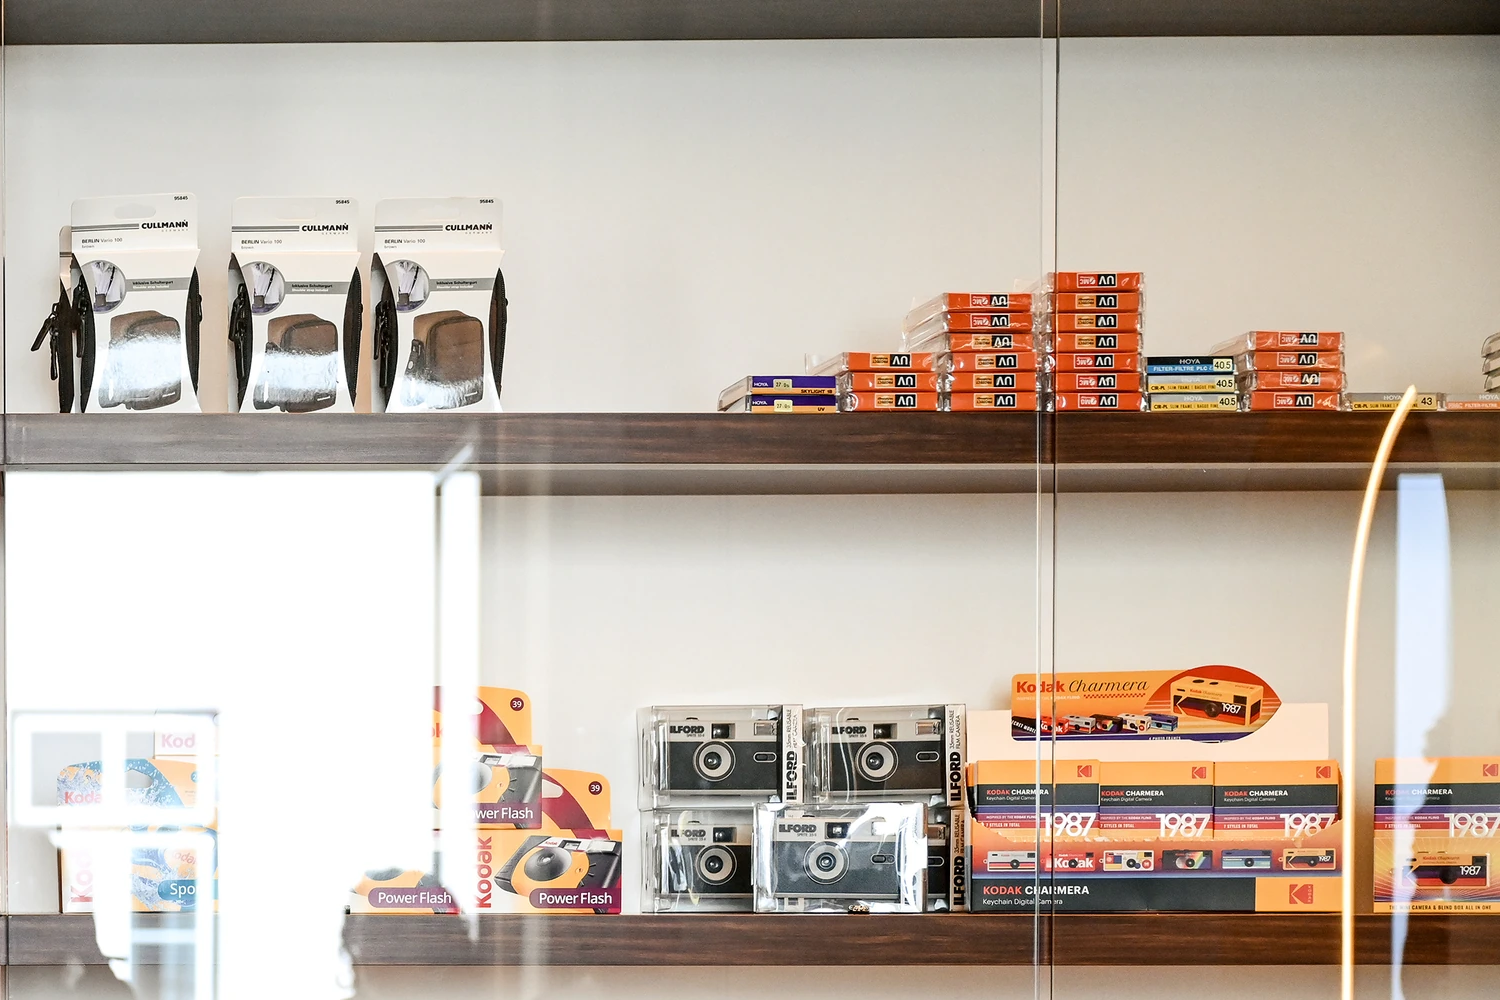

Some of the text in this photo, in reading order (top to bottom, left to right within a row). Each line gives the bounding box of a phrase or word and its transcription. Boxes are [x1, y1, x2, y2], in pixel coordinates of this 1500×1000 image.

[141, 220, 189, 230] CULLMANN
[302, 222, 349, 232] CULLMANN
[445, 222, 492, 232] CULLMANN
[1099, 276, 1116, 286] UV
[991, 296, 1008, 306] UV
[1099, 296, 1115, 306] UV
[992, 316, 1008, 326] UV
[1098, 316, 1115, 326] UV
[994, 336, 1011, 346] UV
[1099, 336, 1115, 346] UV
[1300, 334, 1316, 344] UV
[892, 356, 908, 365] UV
[998, 356, 1016, 366] UV
[1096, 356, 1113, 366] UV
[1299, 354, 1316, 364] UV
[1214, 361, 1232, 370] 40.5
[897, 376, 914, 386] UV
[996, 376, 1013, 386] UV
[1099, 376, 1116, 386] UV
[1216, 380, 1234, 388] 40.5
[1301, 374, 1318, 384] UV
[897, 396, 914, 406] UV
[997, 396, 1014, 406] UV
[1100, 396, 1116, 406] UV
[1219, 398, 1236, 406] 40.5
[1420, 397, 1433, 406] 43
[1016, 679, 1150, 694] Kodak Charmera
[512, 700, 522, 708] 39
[1221, 702, 1242, 714] 1987
[669, 724, 705, 734] ILFORD
[832, 725, 867, 735] ILFORD
[786, 750, 797, 801] ILFORD
[950, 752, 962, 802] ILFORD
[590, 784, 600, 792] 39
[501, 807, 534, 820] Flash
[778, 824, 817, 834] ILFORD
[1040, 812, 1096, 837] 1987
[1155, 813, 1211, 838] 1987
[1280, 812, 1336, 838] 1987
[476, 836, 492, 908] Kodak
[1460, 866, 1481, 875] 1987
[953, 856, 965, 906] ILFORD
[983, 886, 1090, 895] KODAK CHARMERA
[378, 892, 452, 904] Power Flash
[538, 892, 612, 904] Power Flash
[982, 898, 1035, 906] Keychain Digital
